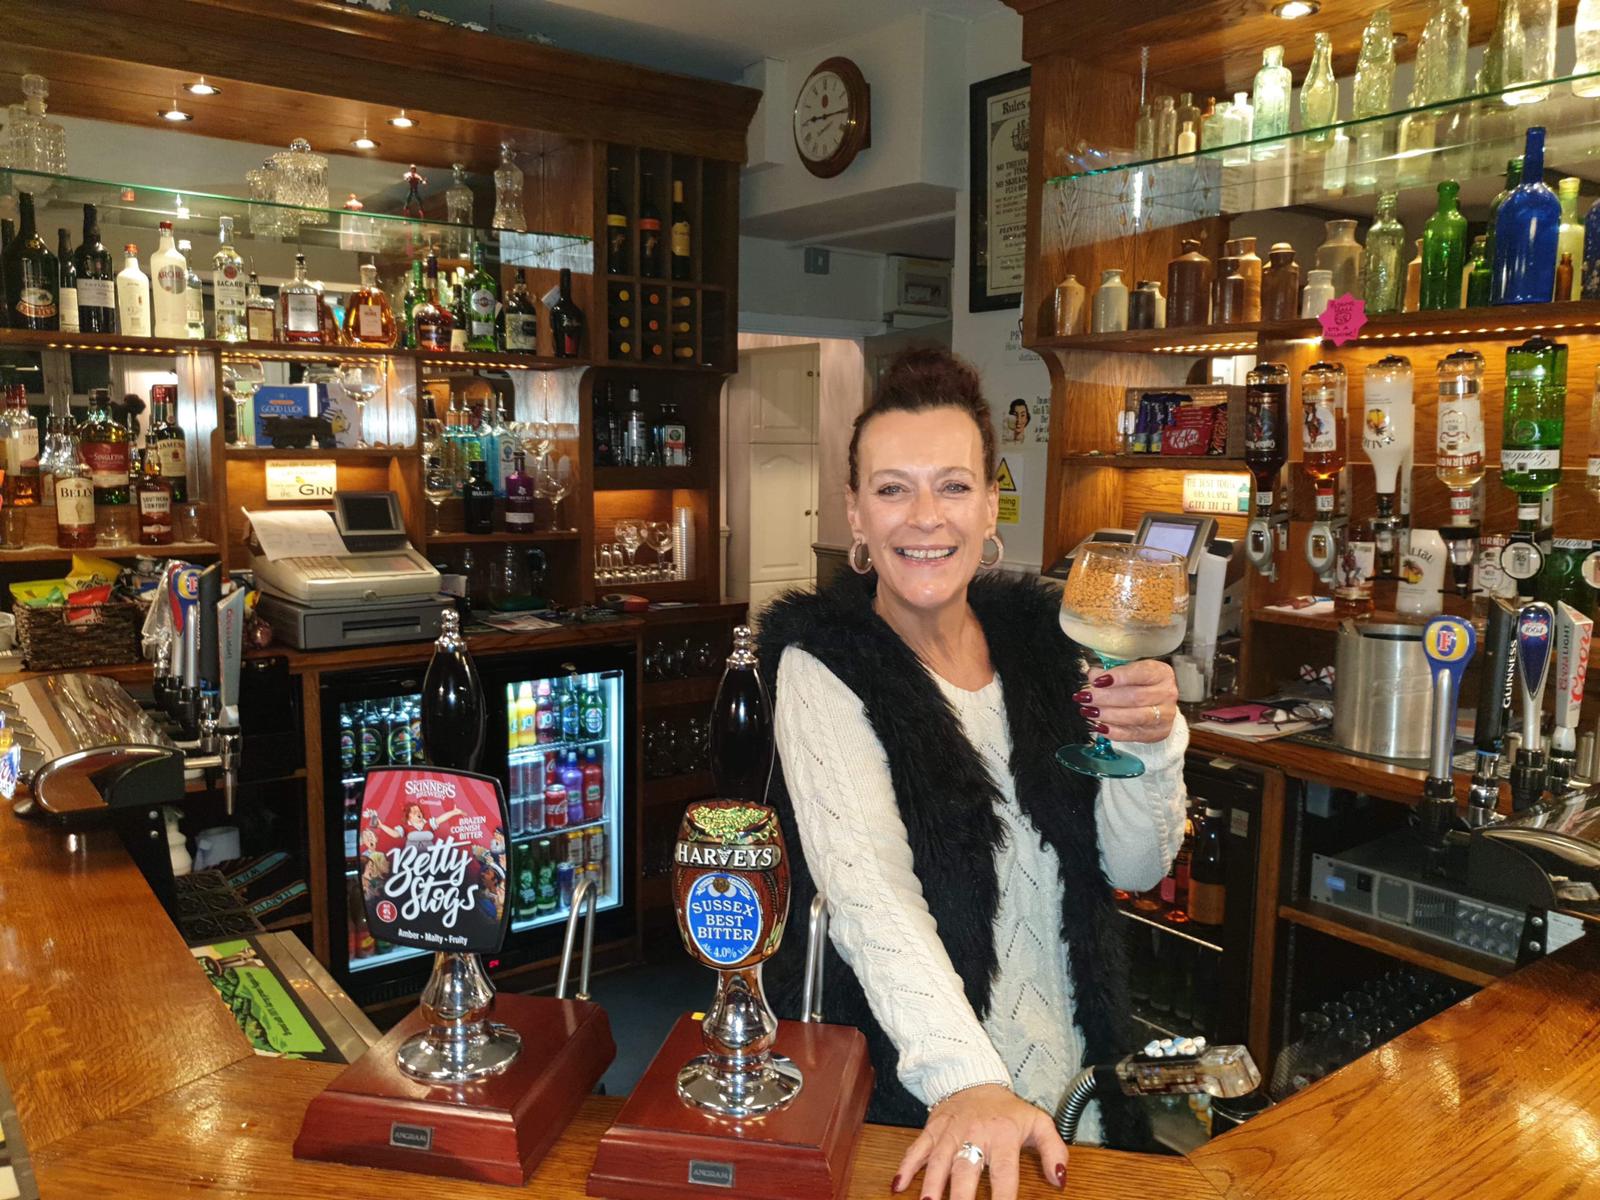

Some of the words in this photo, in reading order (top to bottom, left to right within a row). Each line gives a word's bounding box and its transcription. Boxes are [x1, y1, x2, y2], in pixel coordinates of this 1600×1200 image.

[1002, 100, 1026, 115] Rules
[217, 279, 244, 289] BACARD
[1438, 454, 1479, 467] SMIRNO
[298, 483, 333, 496] GIN
[1503, 639, 1518, 708] GUINNESS
[404, 779, 456, 798] SKINNER'S
[459, 815, 486, 826] BRAZEN
[450, 825, 480, 834] CORNISH
[459, 831, 483, 840] BITTER
[677, 843, 772, 867] HARVEYS
[384, 836, 472, 898] Betty
[401, 875, 479, 928] Stogs
[692, 899, 755, 918] SUSSEX
[706, 914, 745, 928] BEST
[398, 928, 419, 940] Amber
[424, 931, 443, 945] Malty
[449, 934, 468, 947] Fruity
[697, 926, 754, 941] BITTER
[713, 946, 737, 959] 4.0%
[692, 1168, 729, 1180] ANGRAM
